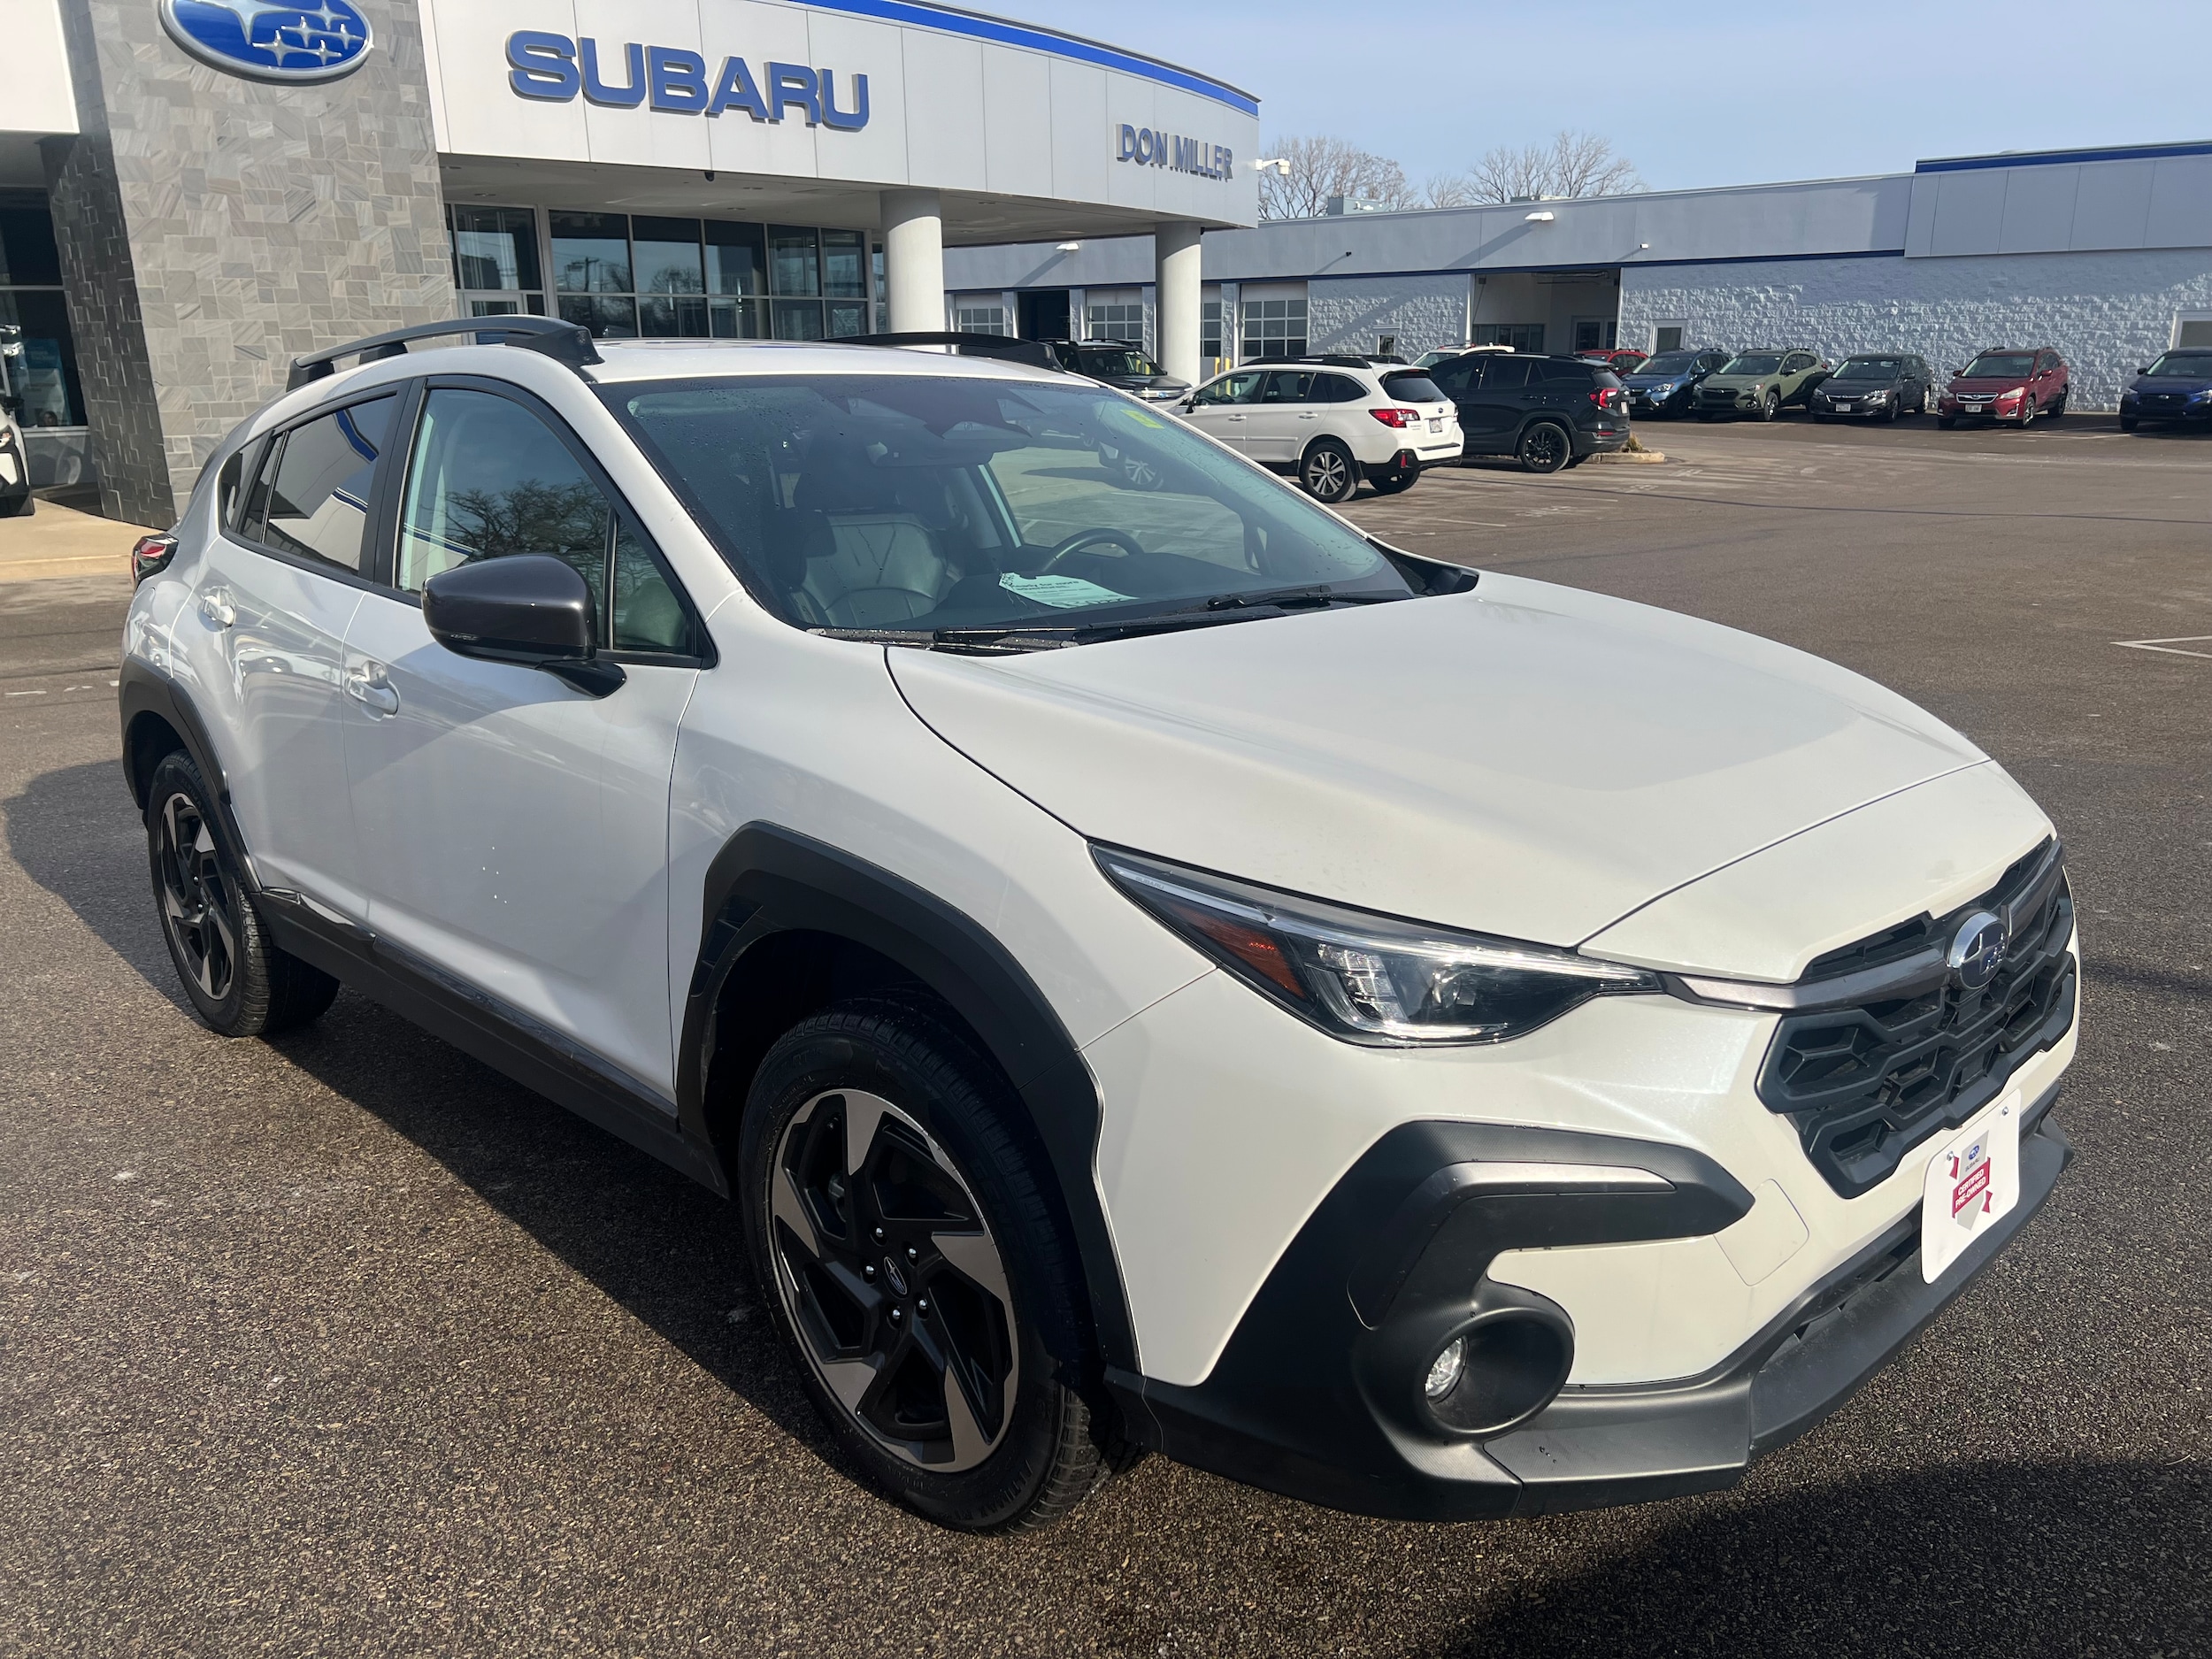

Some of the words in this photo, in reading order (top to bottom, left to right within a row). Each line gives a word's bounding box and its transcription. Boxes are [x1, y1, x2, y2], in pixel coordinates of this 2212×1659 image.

[504, 29, 872, 133] SUBARU
[1116, 123, 1168, 165] DON
[1170, 134, 1233, 181] MILLER
[1135, 876, 1164, 889] SUBARU
[1955, 1176, 1986, 1209] PRE-OWNED
[1957, 1168, 1985, 1196] CERTIFIED
